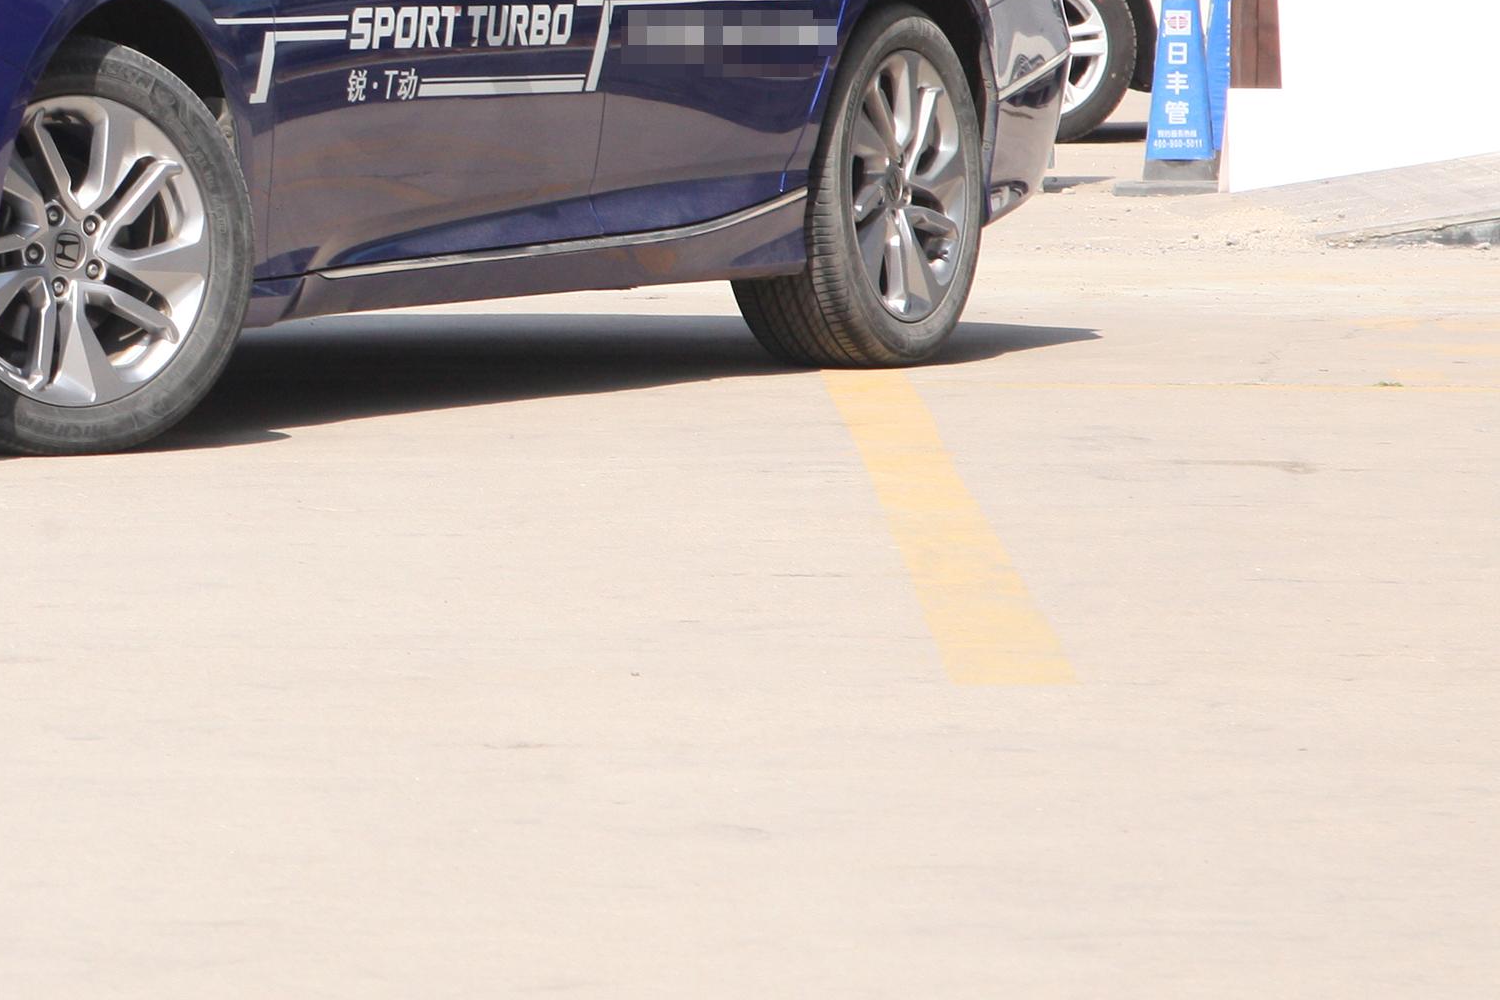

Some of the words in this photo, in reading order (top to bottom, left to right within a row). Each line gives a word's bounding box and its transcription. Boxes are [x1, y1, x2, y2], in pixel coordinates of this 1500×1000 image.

[350, 6, 462, 50] SPORT
[467, 4, 574, 48] TURBO
[1164, 42, 1189, 125] 日丰管
